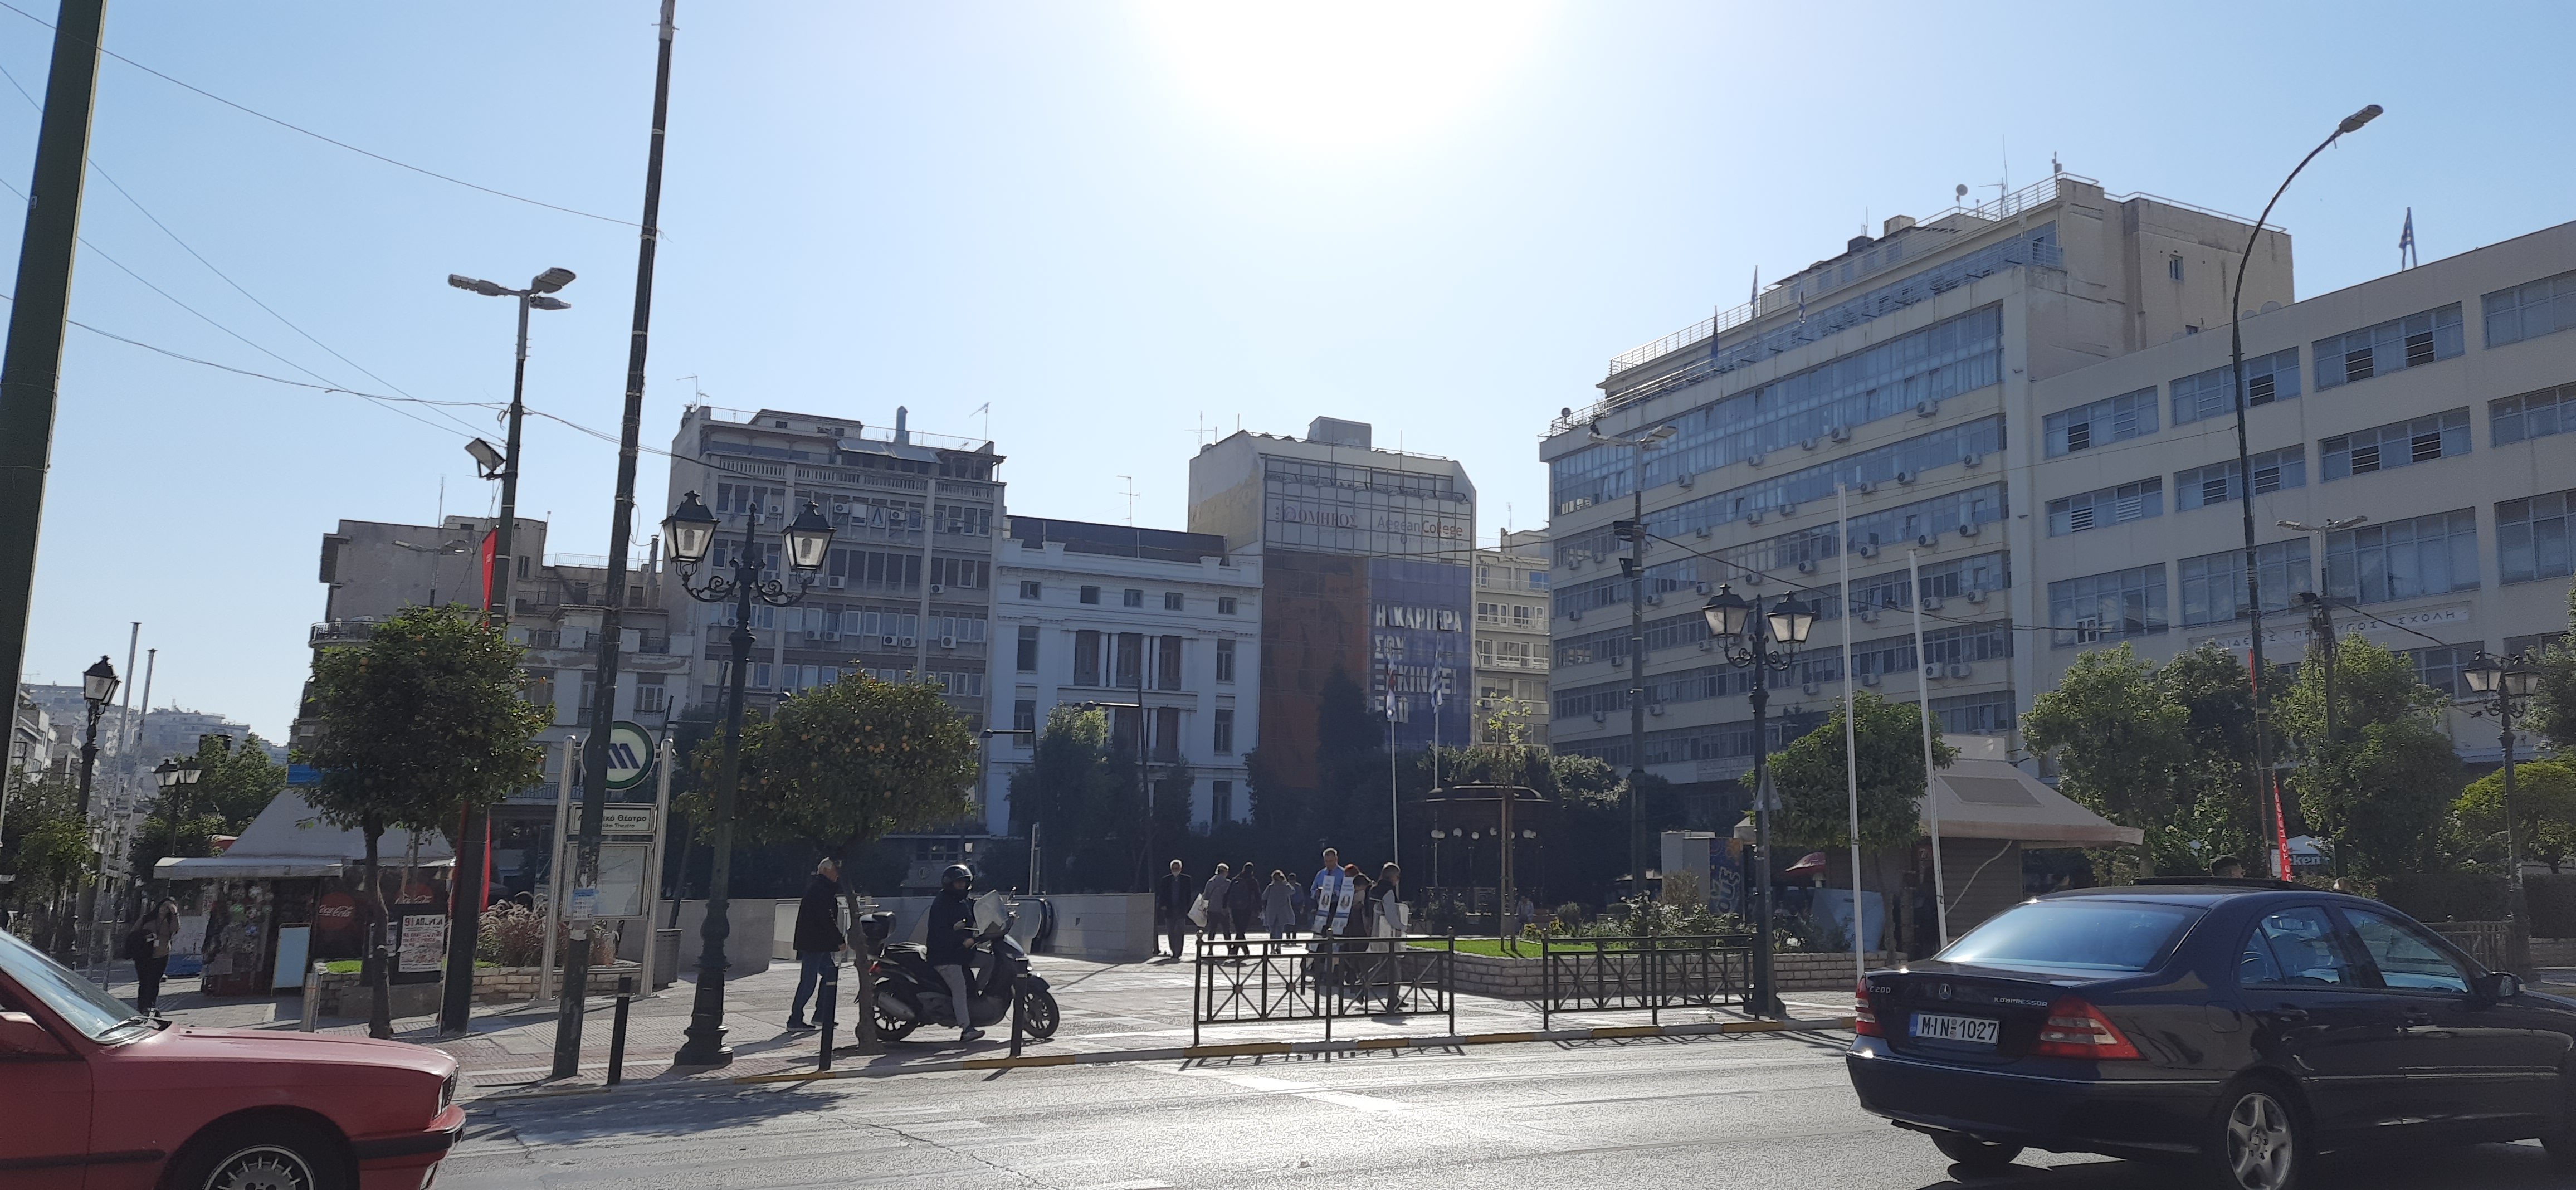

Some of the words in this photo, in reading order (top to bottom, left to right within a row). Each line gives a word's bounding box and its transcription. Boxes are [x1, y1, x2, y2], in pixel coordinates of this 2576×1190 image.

[2398, 611, 2455, 625] ΣΧΟΛΗ
[617, 815, 647, 823] Θέατρο
[1994, 997, 2048, 1007] KOMPRESSOR
